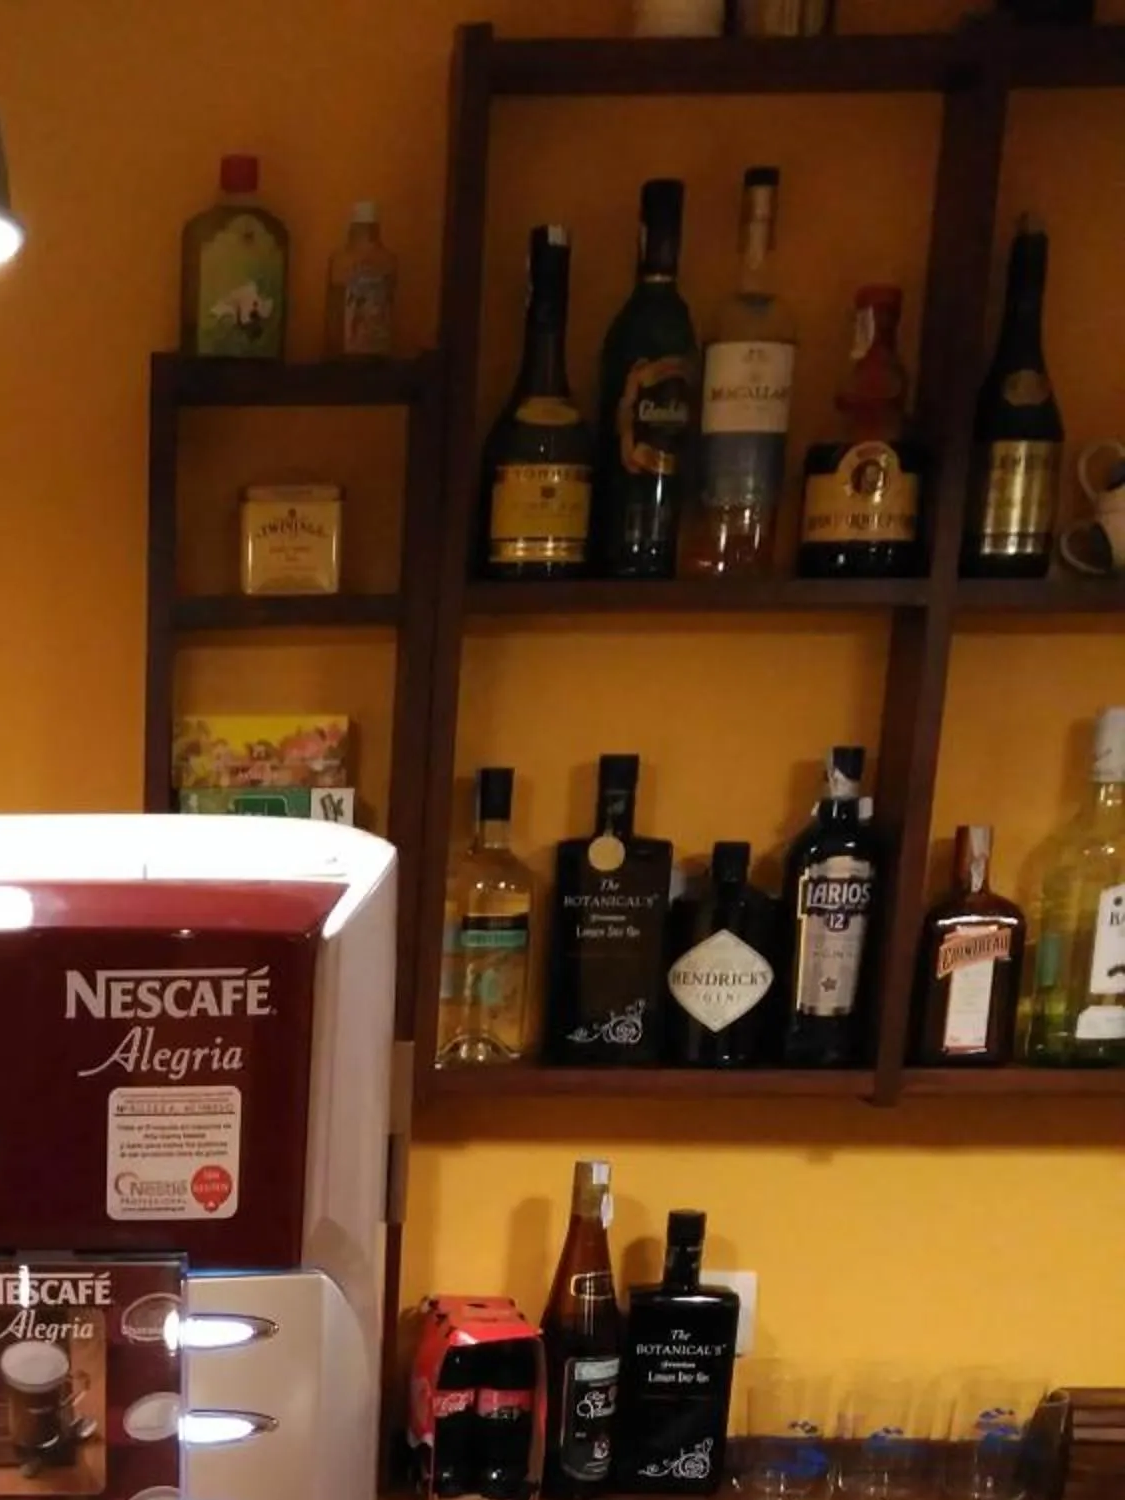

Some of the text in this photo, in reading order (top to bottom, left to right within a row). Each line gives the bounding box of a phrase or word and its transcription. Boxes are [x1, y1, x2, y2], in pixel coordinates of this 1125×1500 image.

[806, 881, 873, 909] LARIOS
[829, 912, 845, 929] 12
[65, 965, 273, 1020] NESCAFÉ
[78, 1025, 243, 1079] Alegria
